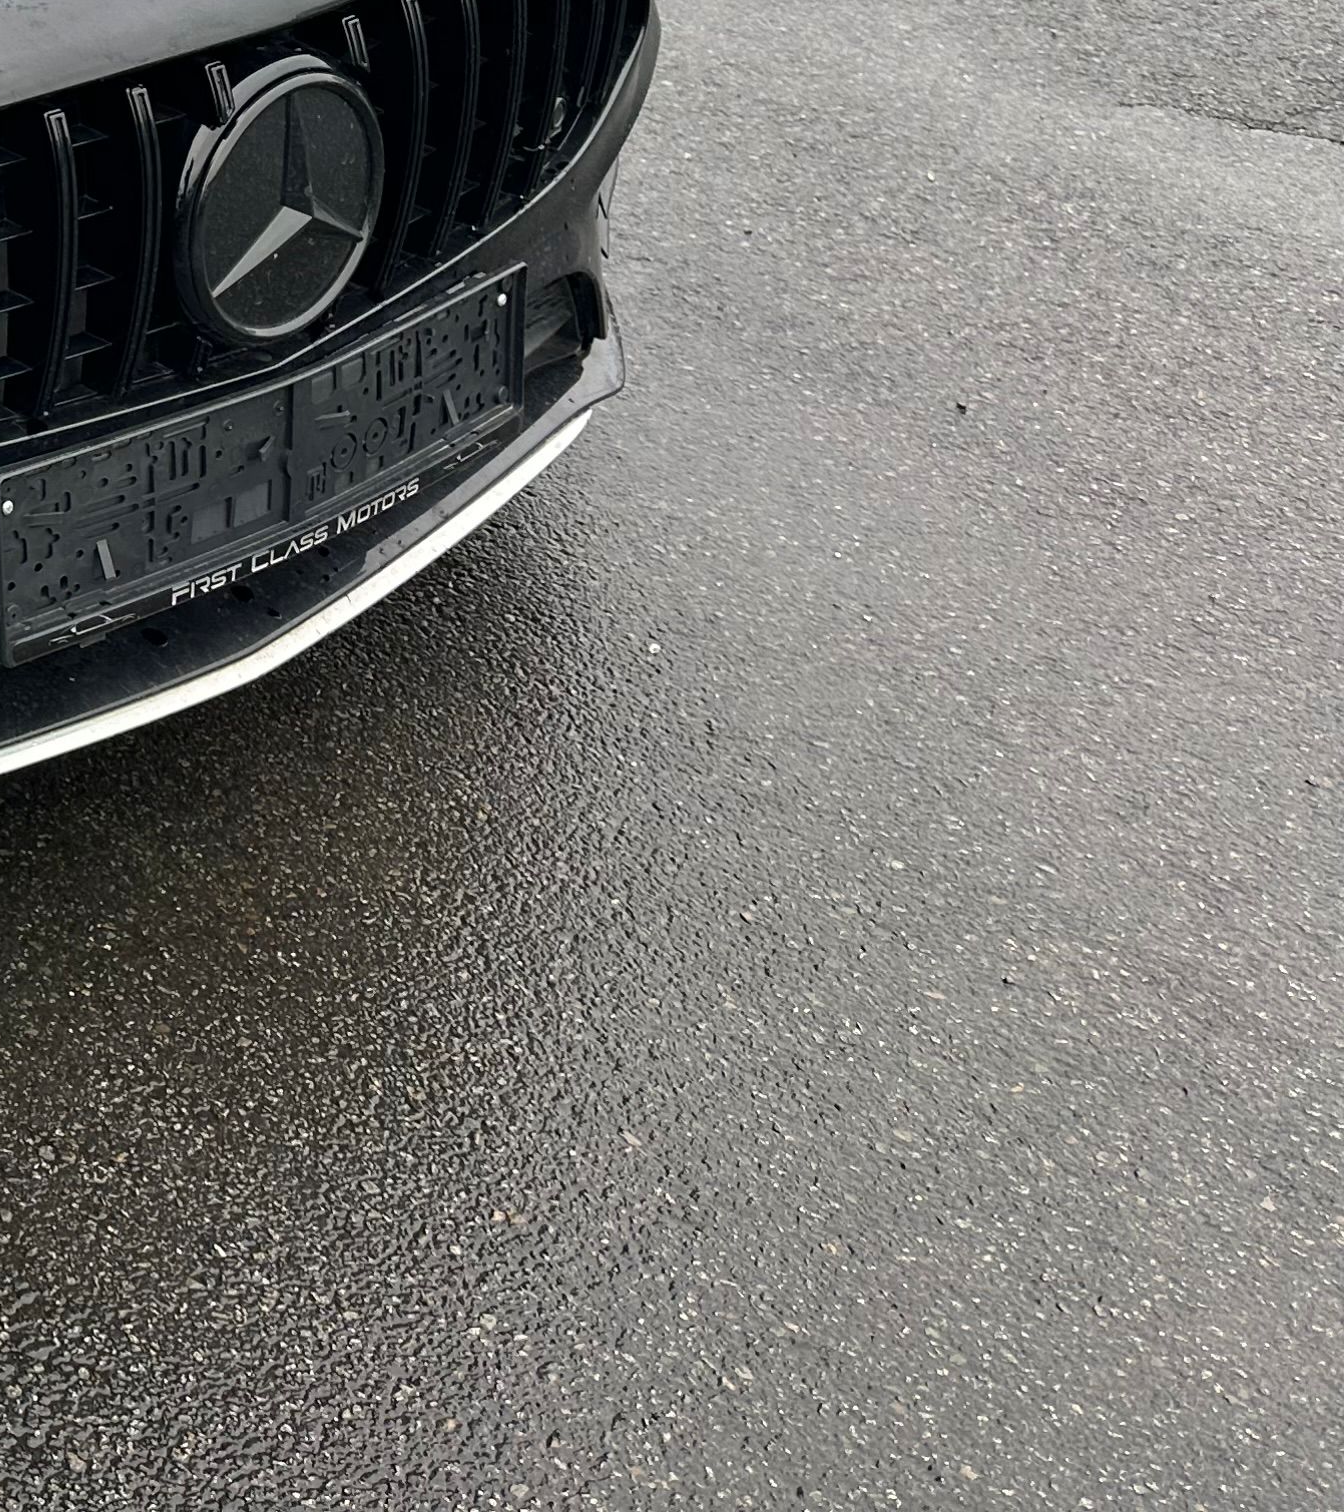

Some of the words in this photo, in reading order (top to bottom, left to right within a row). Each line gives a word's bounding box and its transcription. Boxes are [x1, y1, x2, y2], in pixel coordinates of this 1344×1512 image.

[171, 562, 243, 606] FIRST
[250, 525, 329, 573] CLASS
[336, 477, 420, 534] MOTORS
